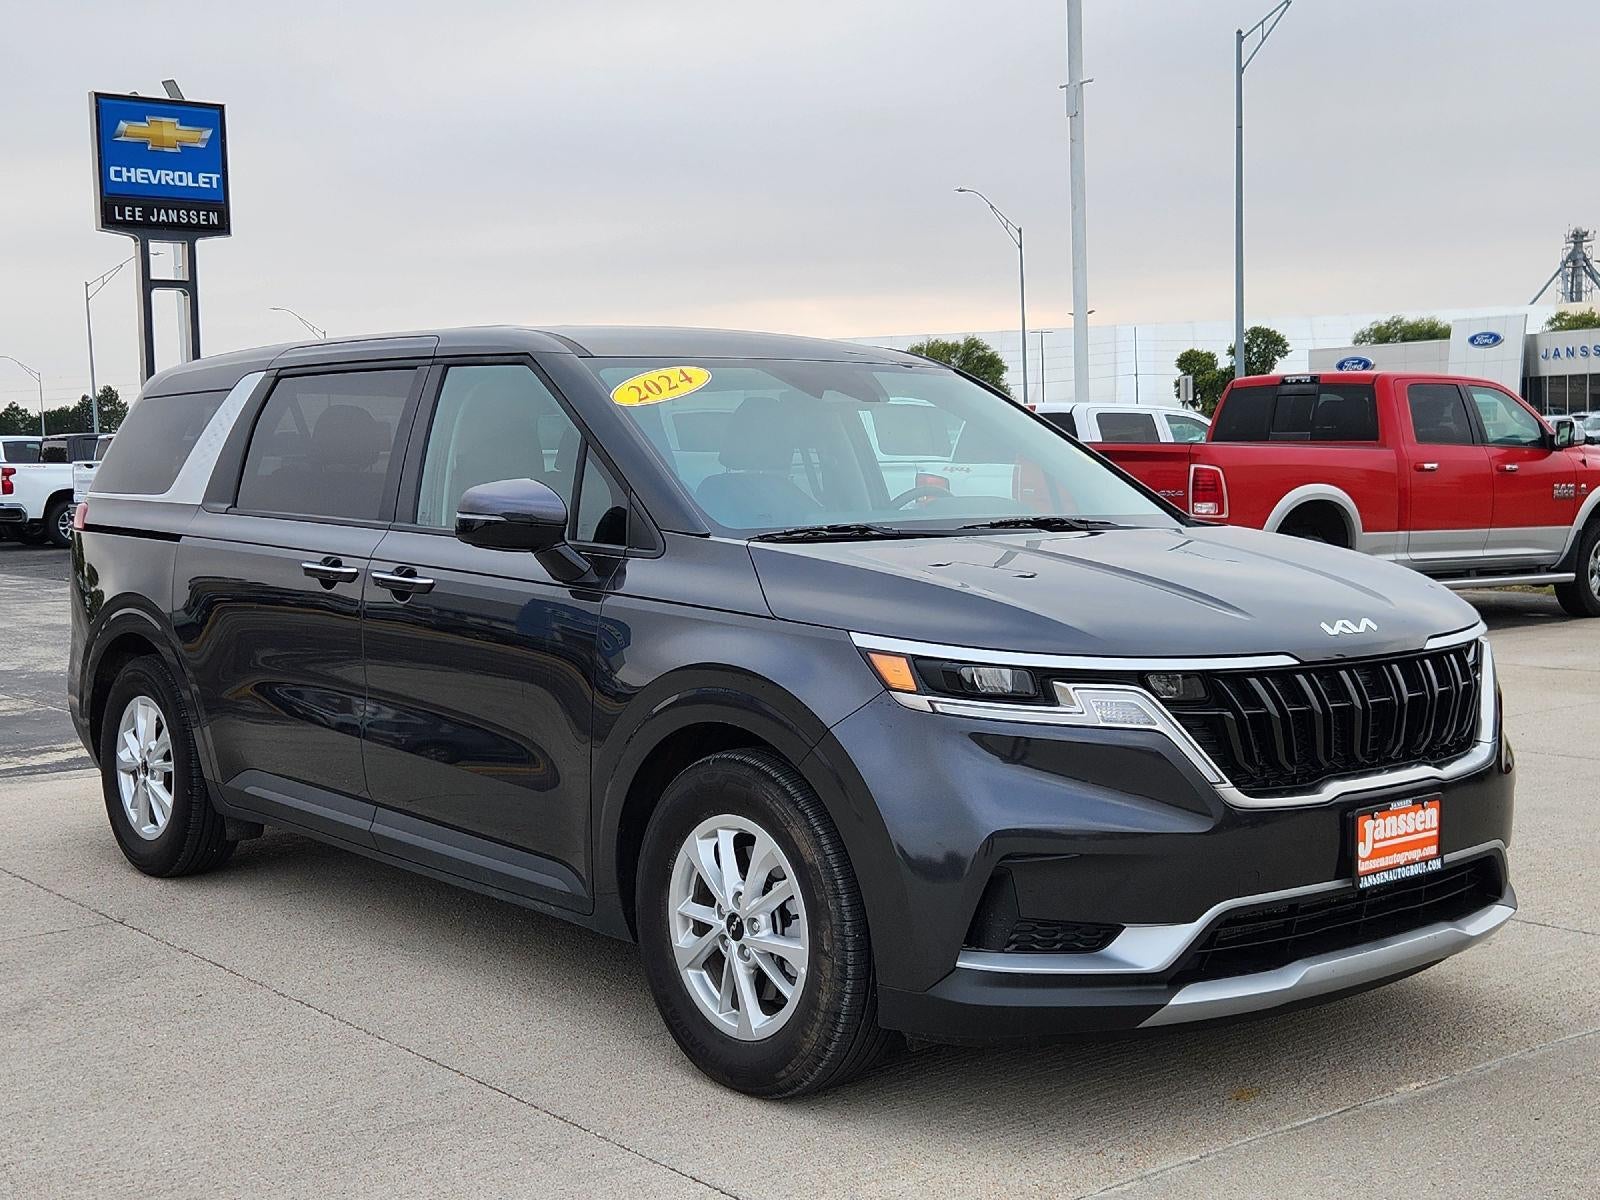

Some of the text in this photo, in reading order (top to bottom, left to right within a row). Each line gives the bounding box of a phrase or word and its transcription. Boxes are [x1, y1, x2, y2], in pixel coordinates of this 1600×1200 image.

[109, 166, 220, 189] CHEVROLET
[114, 205, 219, 225] LEE JANSSEN
[627, 368, 693, 402] 2024
[1358, 807, 1438, 858] Janssen
[1359, 858, 1442, 888] JANSSENAUTOGROUP.COM
